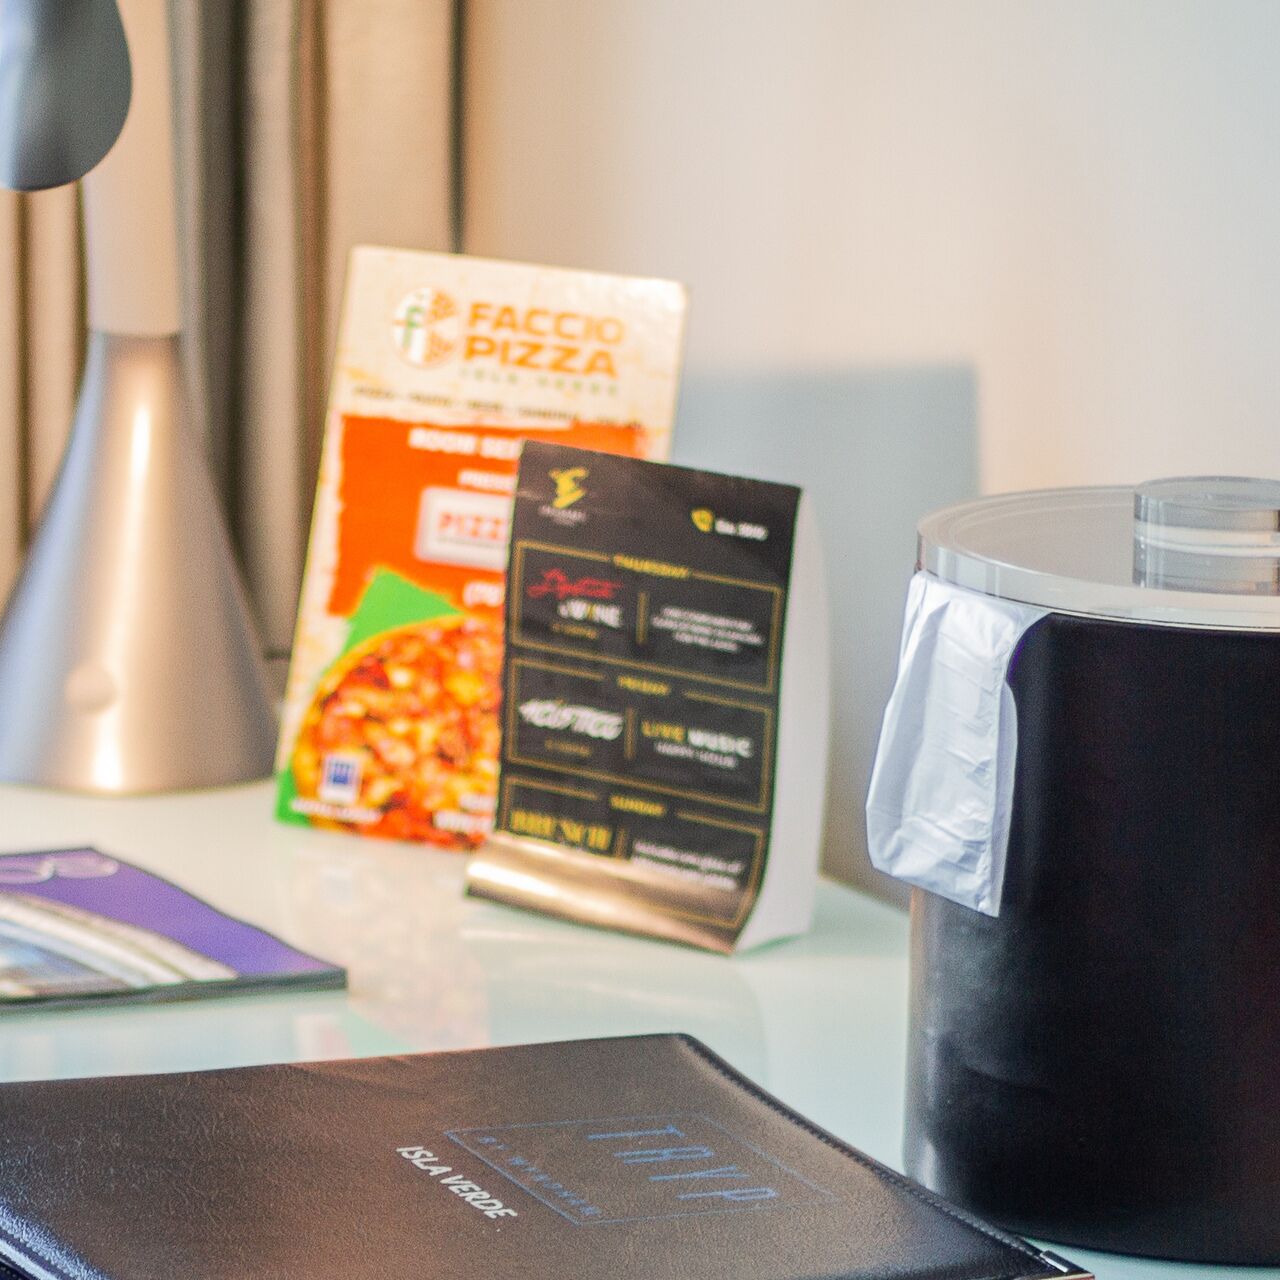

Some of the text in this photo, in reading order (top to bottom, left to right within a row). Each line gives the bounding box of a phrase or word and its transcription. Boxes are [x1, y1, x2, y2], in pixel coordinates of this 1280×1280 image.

[468, 302, 625, 345] FACCIO
[463, 334, 618, 379] PIZZA
[641, 719, 753, 759] LIVE MUSIC
[396, 1146, 518, 1220] ISLA VERDE
